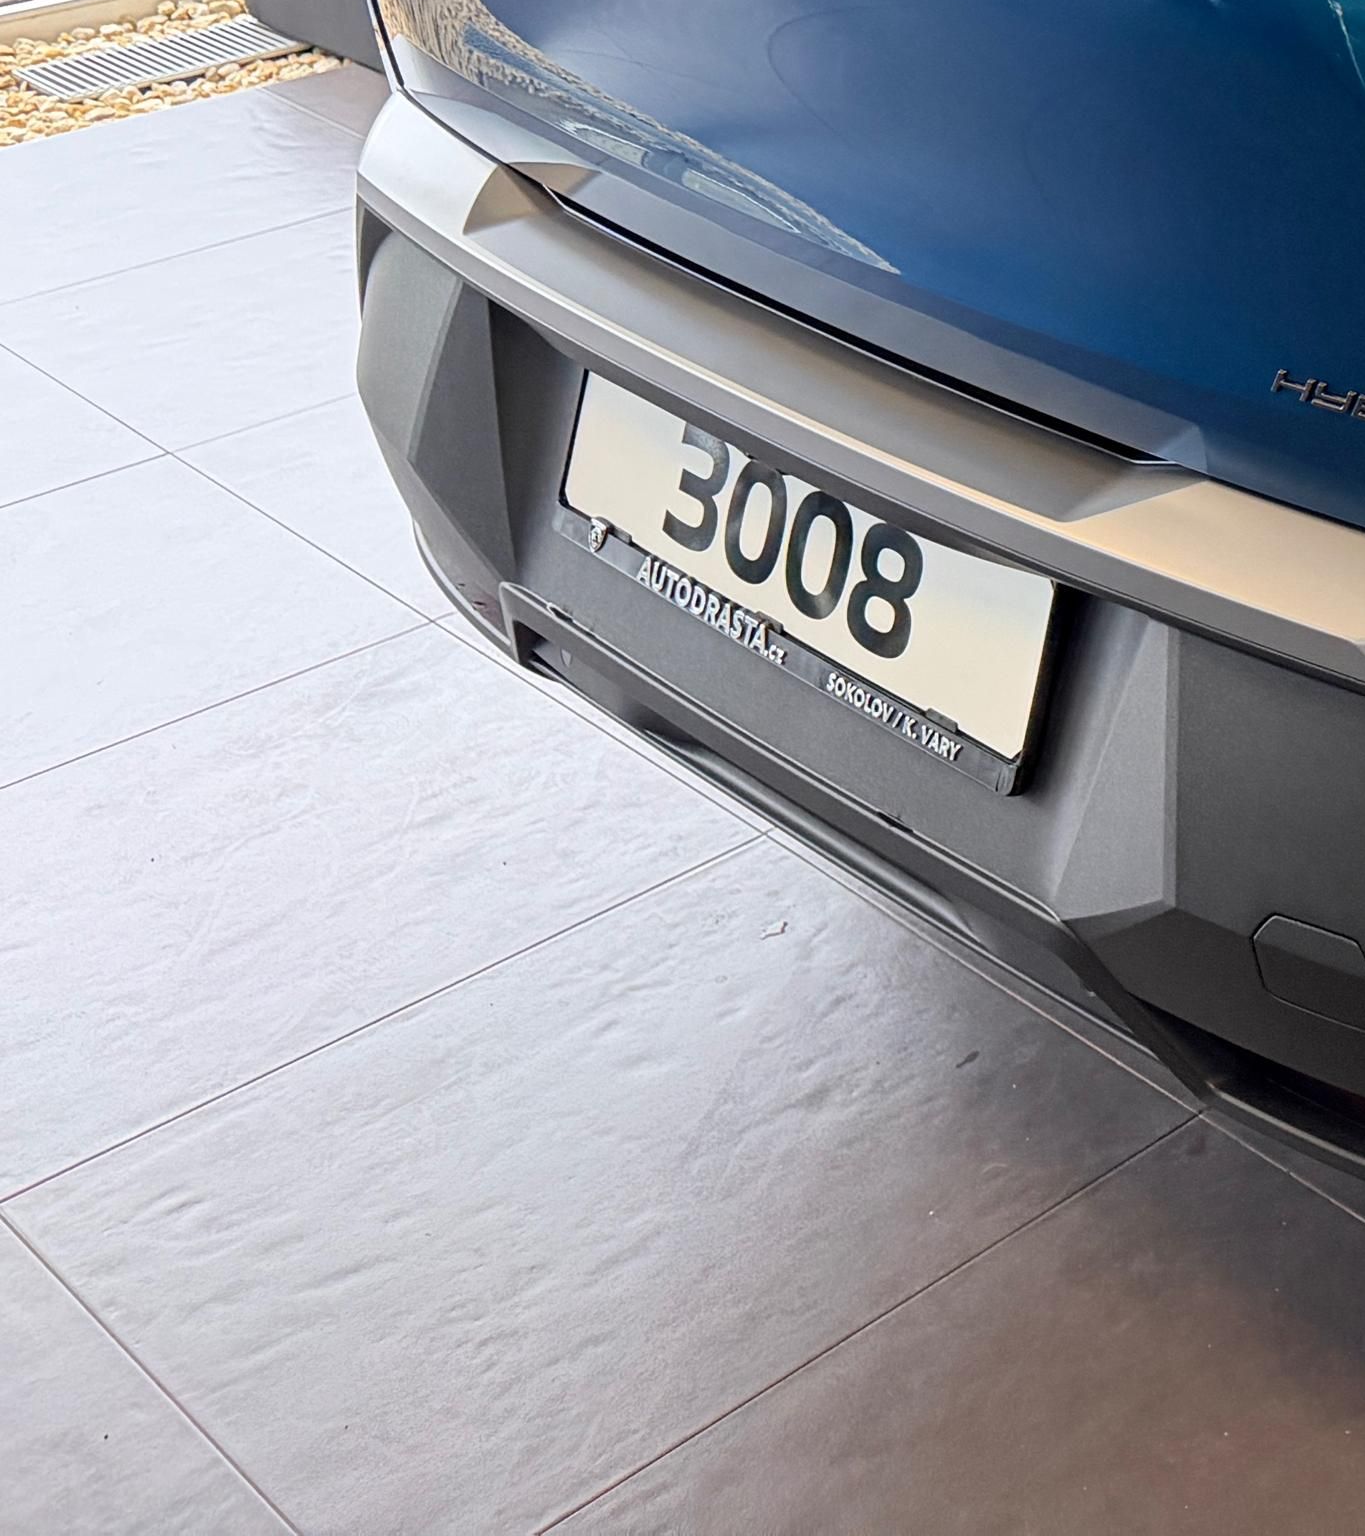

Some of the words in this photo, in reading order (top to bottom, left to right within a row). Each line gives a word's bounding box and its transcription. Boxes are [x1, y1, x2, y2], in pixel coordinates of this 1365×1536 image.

[662, 421, 924, 659] 3008
[826, 672, 894, 724] SOKOLOV
[902, 715, 918, 740] K.
[921, 724, 962, 761] VARY
